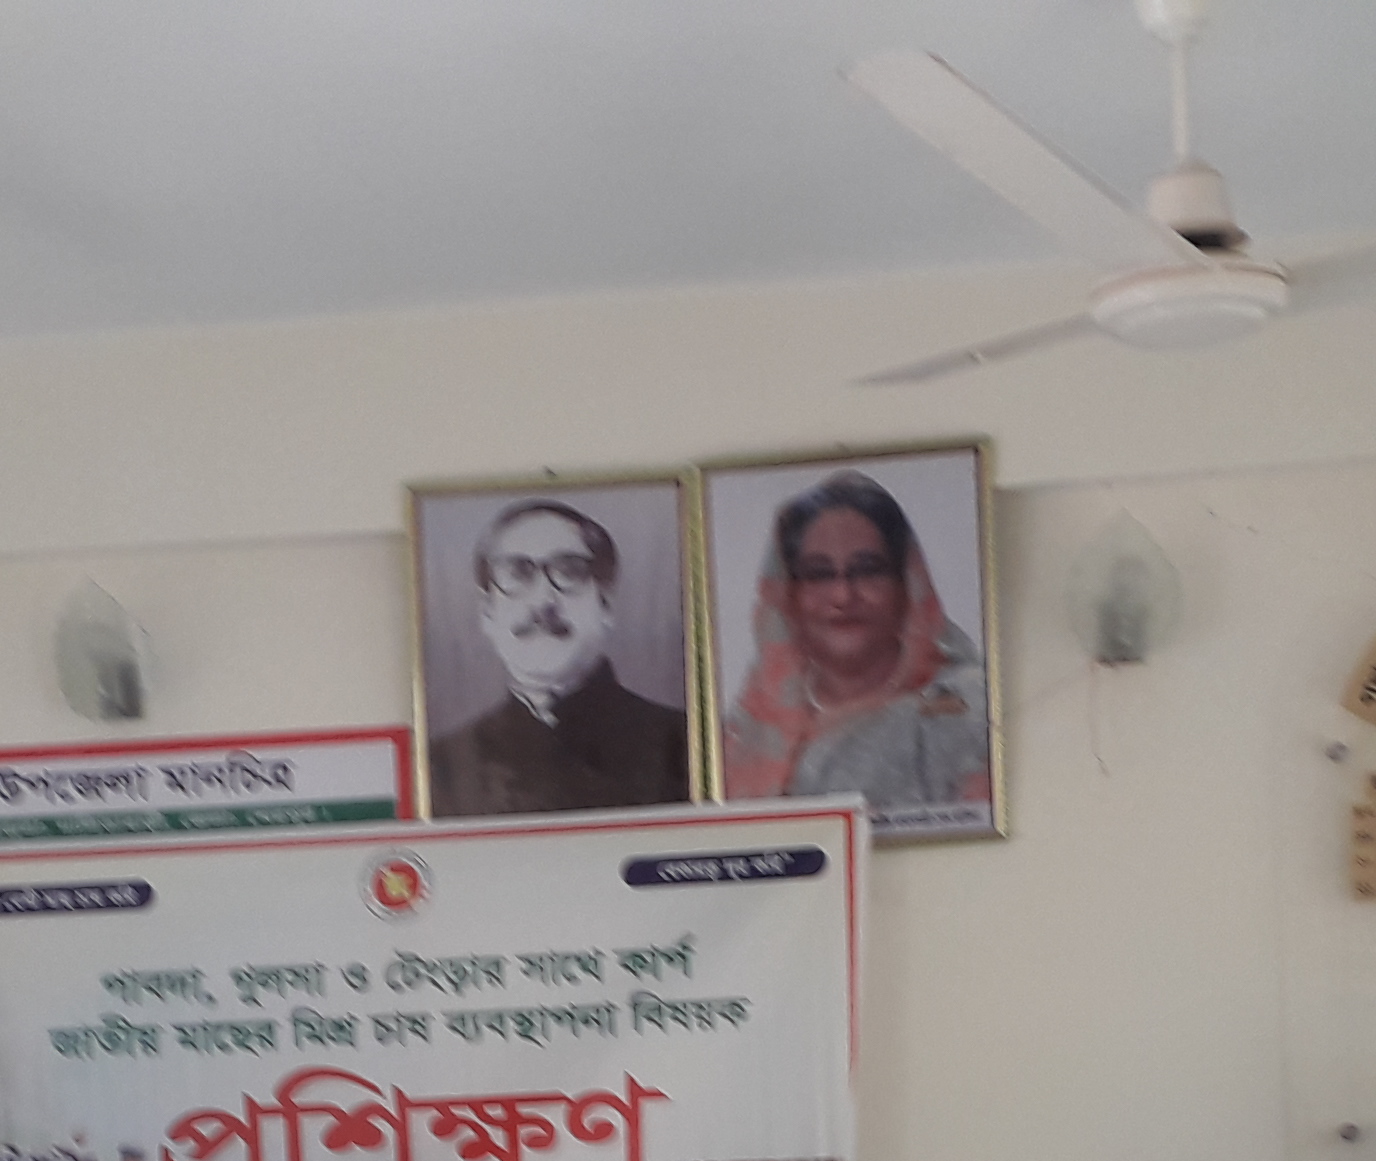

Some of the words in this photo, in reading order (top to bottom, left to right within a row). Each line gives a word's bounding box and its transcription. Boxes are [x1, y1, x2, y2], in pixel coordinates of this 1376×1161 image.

[156, 749, 297, 797] মানচিত্র
[339, 961, 372, 994] ও
[514, 945, 606, 987] সাথে
[612, 930, 698, 982] কার্প
[48, 1011, 164, 1062] জাতীয়
[169, 1017, 278, 1060] মাছের
[289, 1004, 361, 1052] মিশ্র
[367, 1009, 436, 1048] চাষ
[438, 998, 622, 1050] ব্যবস্থাপনা
[628, 987, 754, 1038] বিষয়ক
